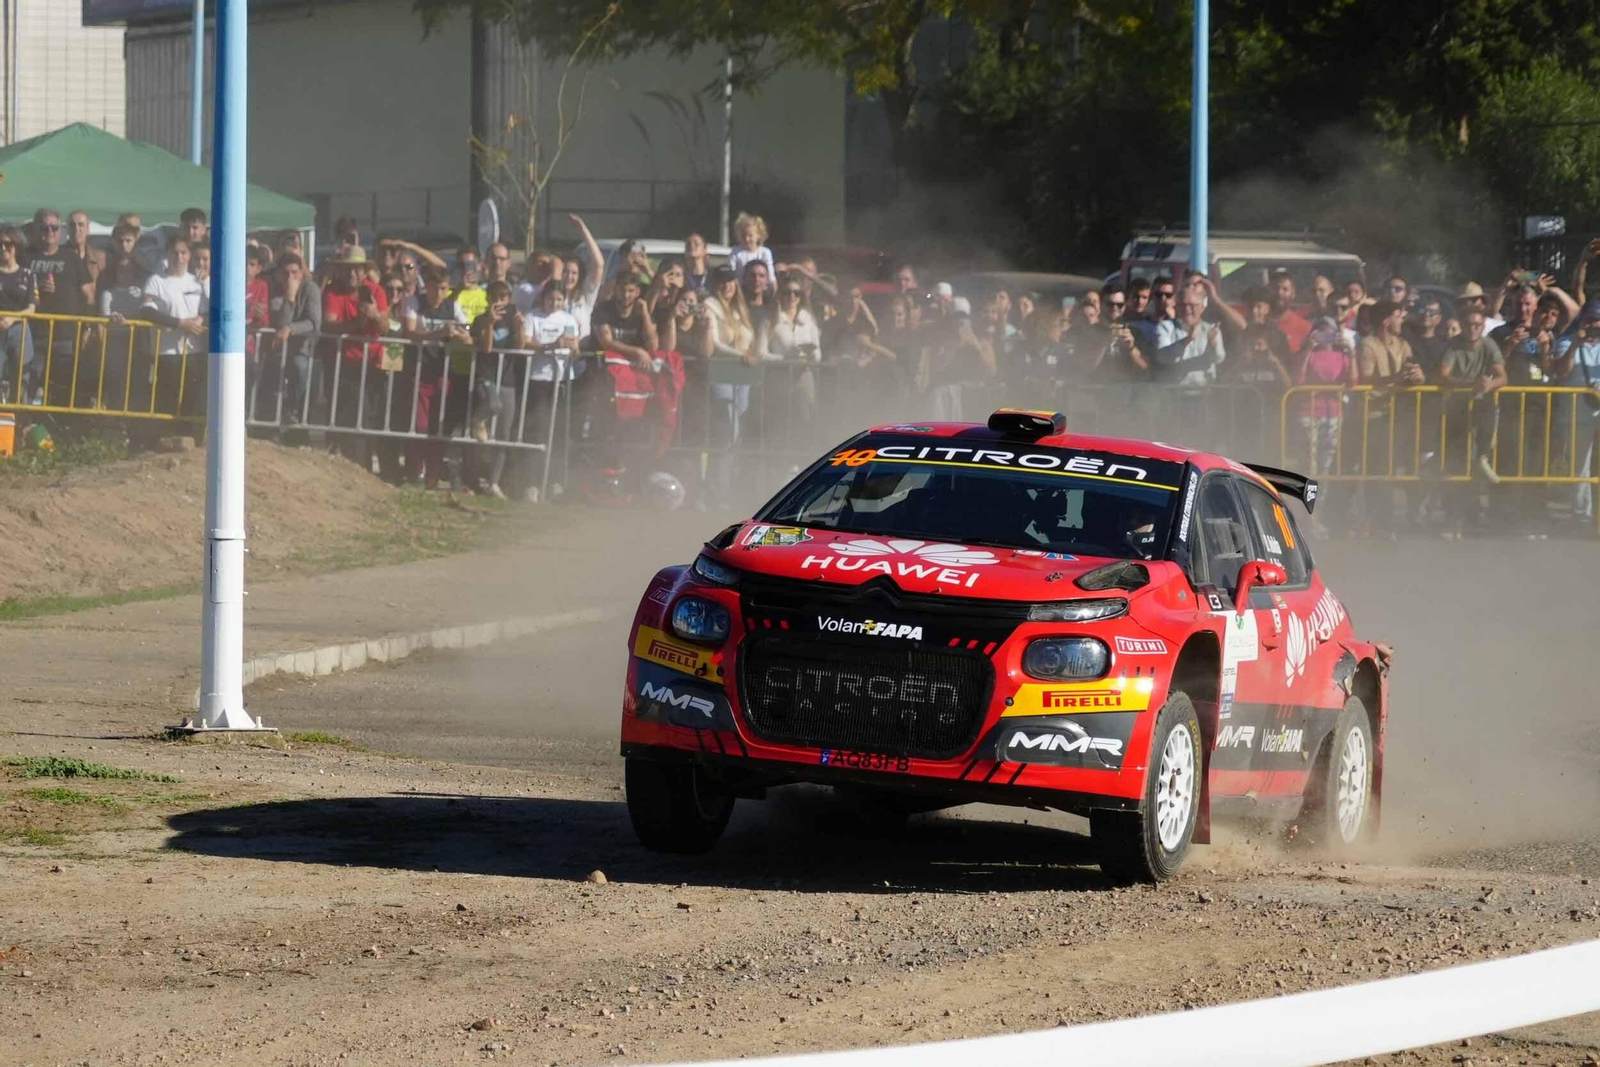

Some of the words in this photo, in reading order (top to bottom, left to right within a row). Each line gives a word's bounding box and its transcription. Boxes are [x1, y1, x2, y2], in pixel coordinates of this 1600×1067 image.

[801, 554, 981, 588] HUAWEI
[647, 638, 700, 669] PIRELLI
[1119, 640, 1164, 652] TURINI
[640, 681, 716, 719] MMR
[1042, 689, 1122, 708] PIRELLI
[1008, 731, 1124, 756] MMR
